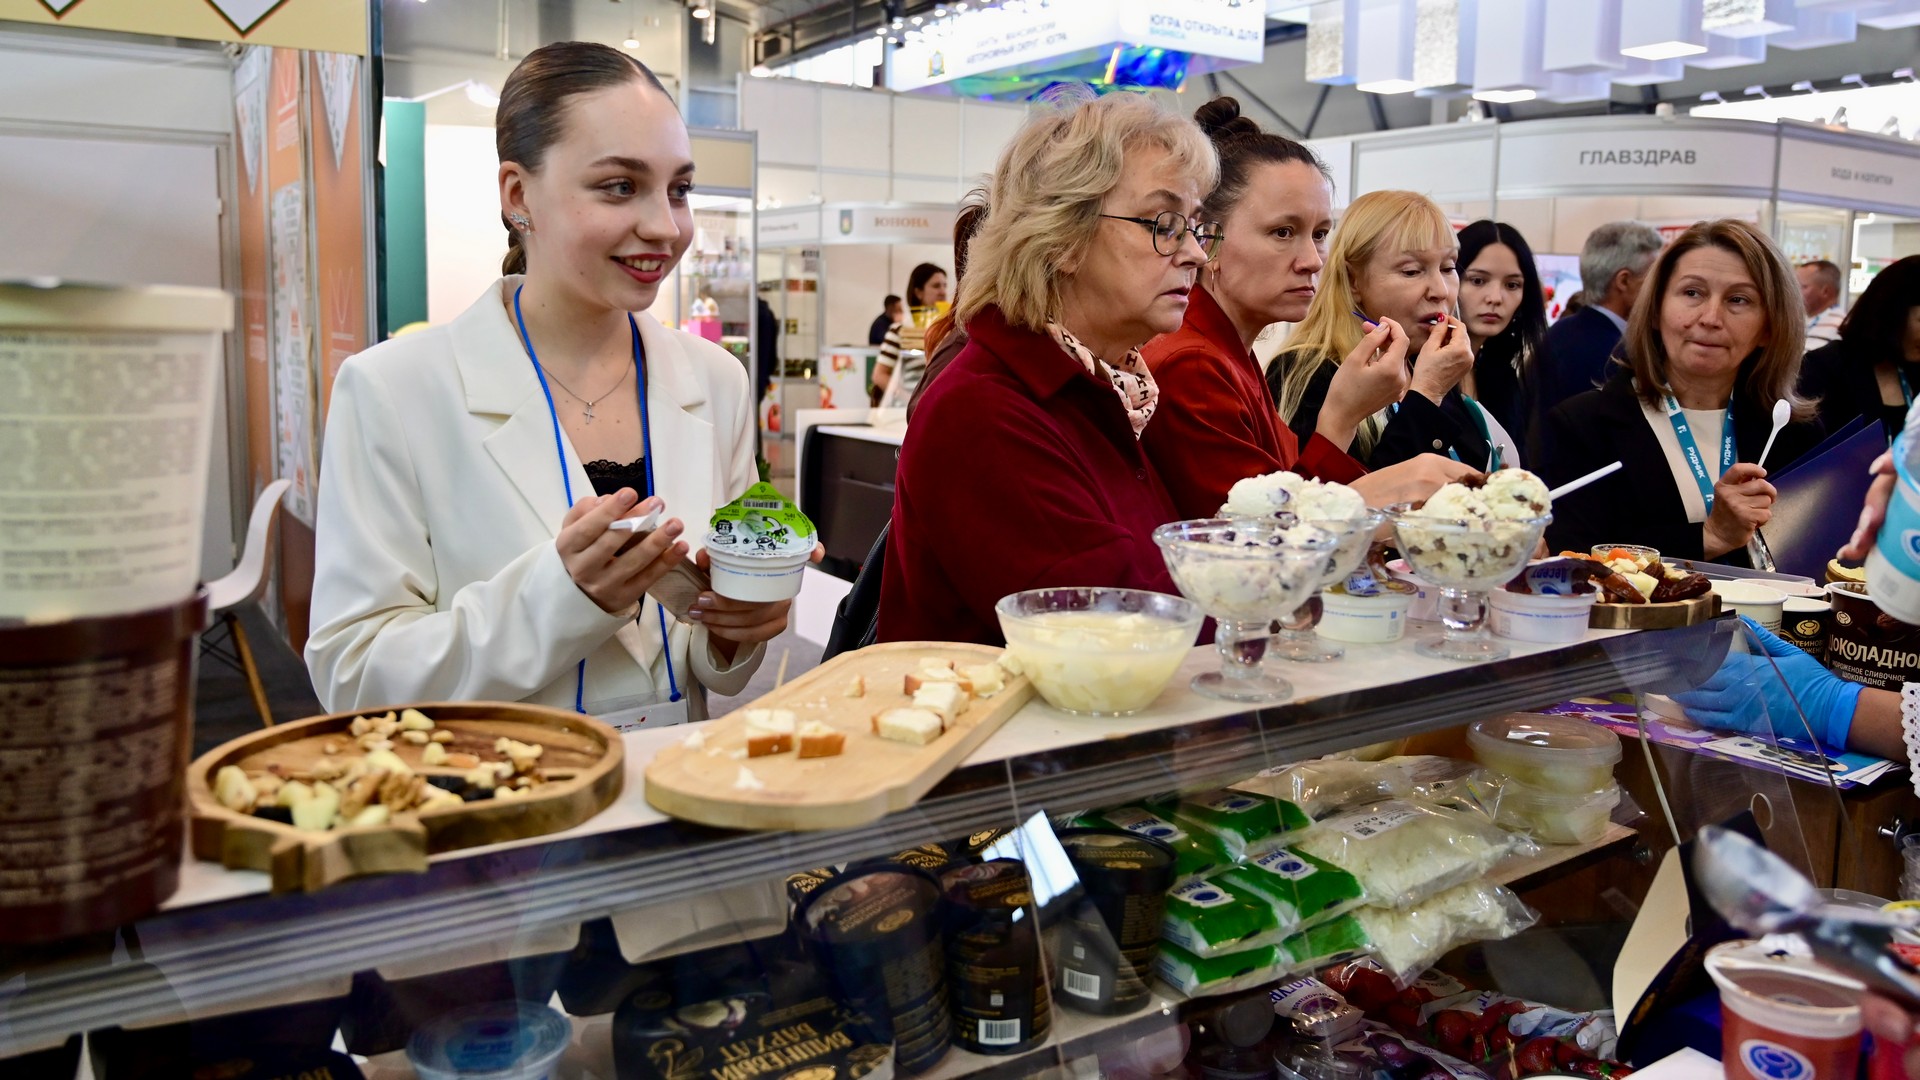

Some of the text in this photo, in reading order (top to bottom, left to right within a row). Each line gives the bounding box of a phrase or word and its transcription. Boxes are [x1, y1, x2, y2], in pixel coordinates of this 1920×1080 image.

[1579, 149, 1697, 166] ГЛАВЗДРАВ
[1723, 435, 1732, 466] РУДНИК
[1686, 446, 1706, 479] РУДНИК
[1841, 671, 1887, 688] ШОКОЛАДНОЕ
[1864, 670, 1906, 683] СЛИВОЧНОЕ
